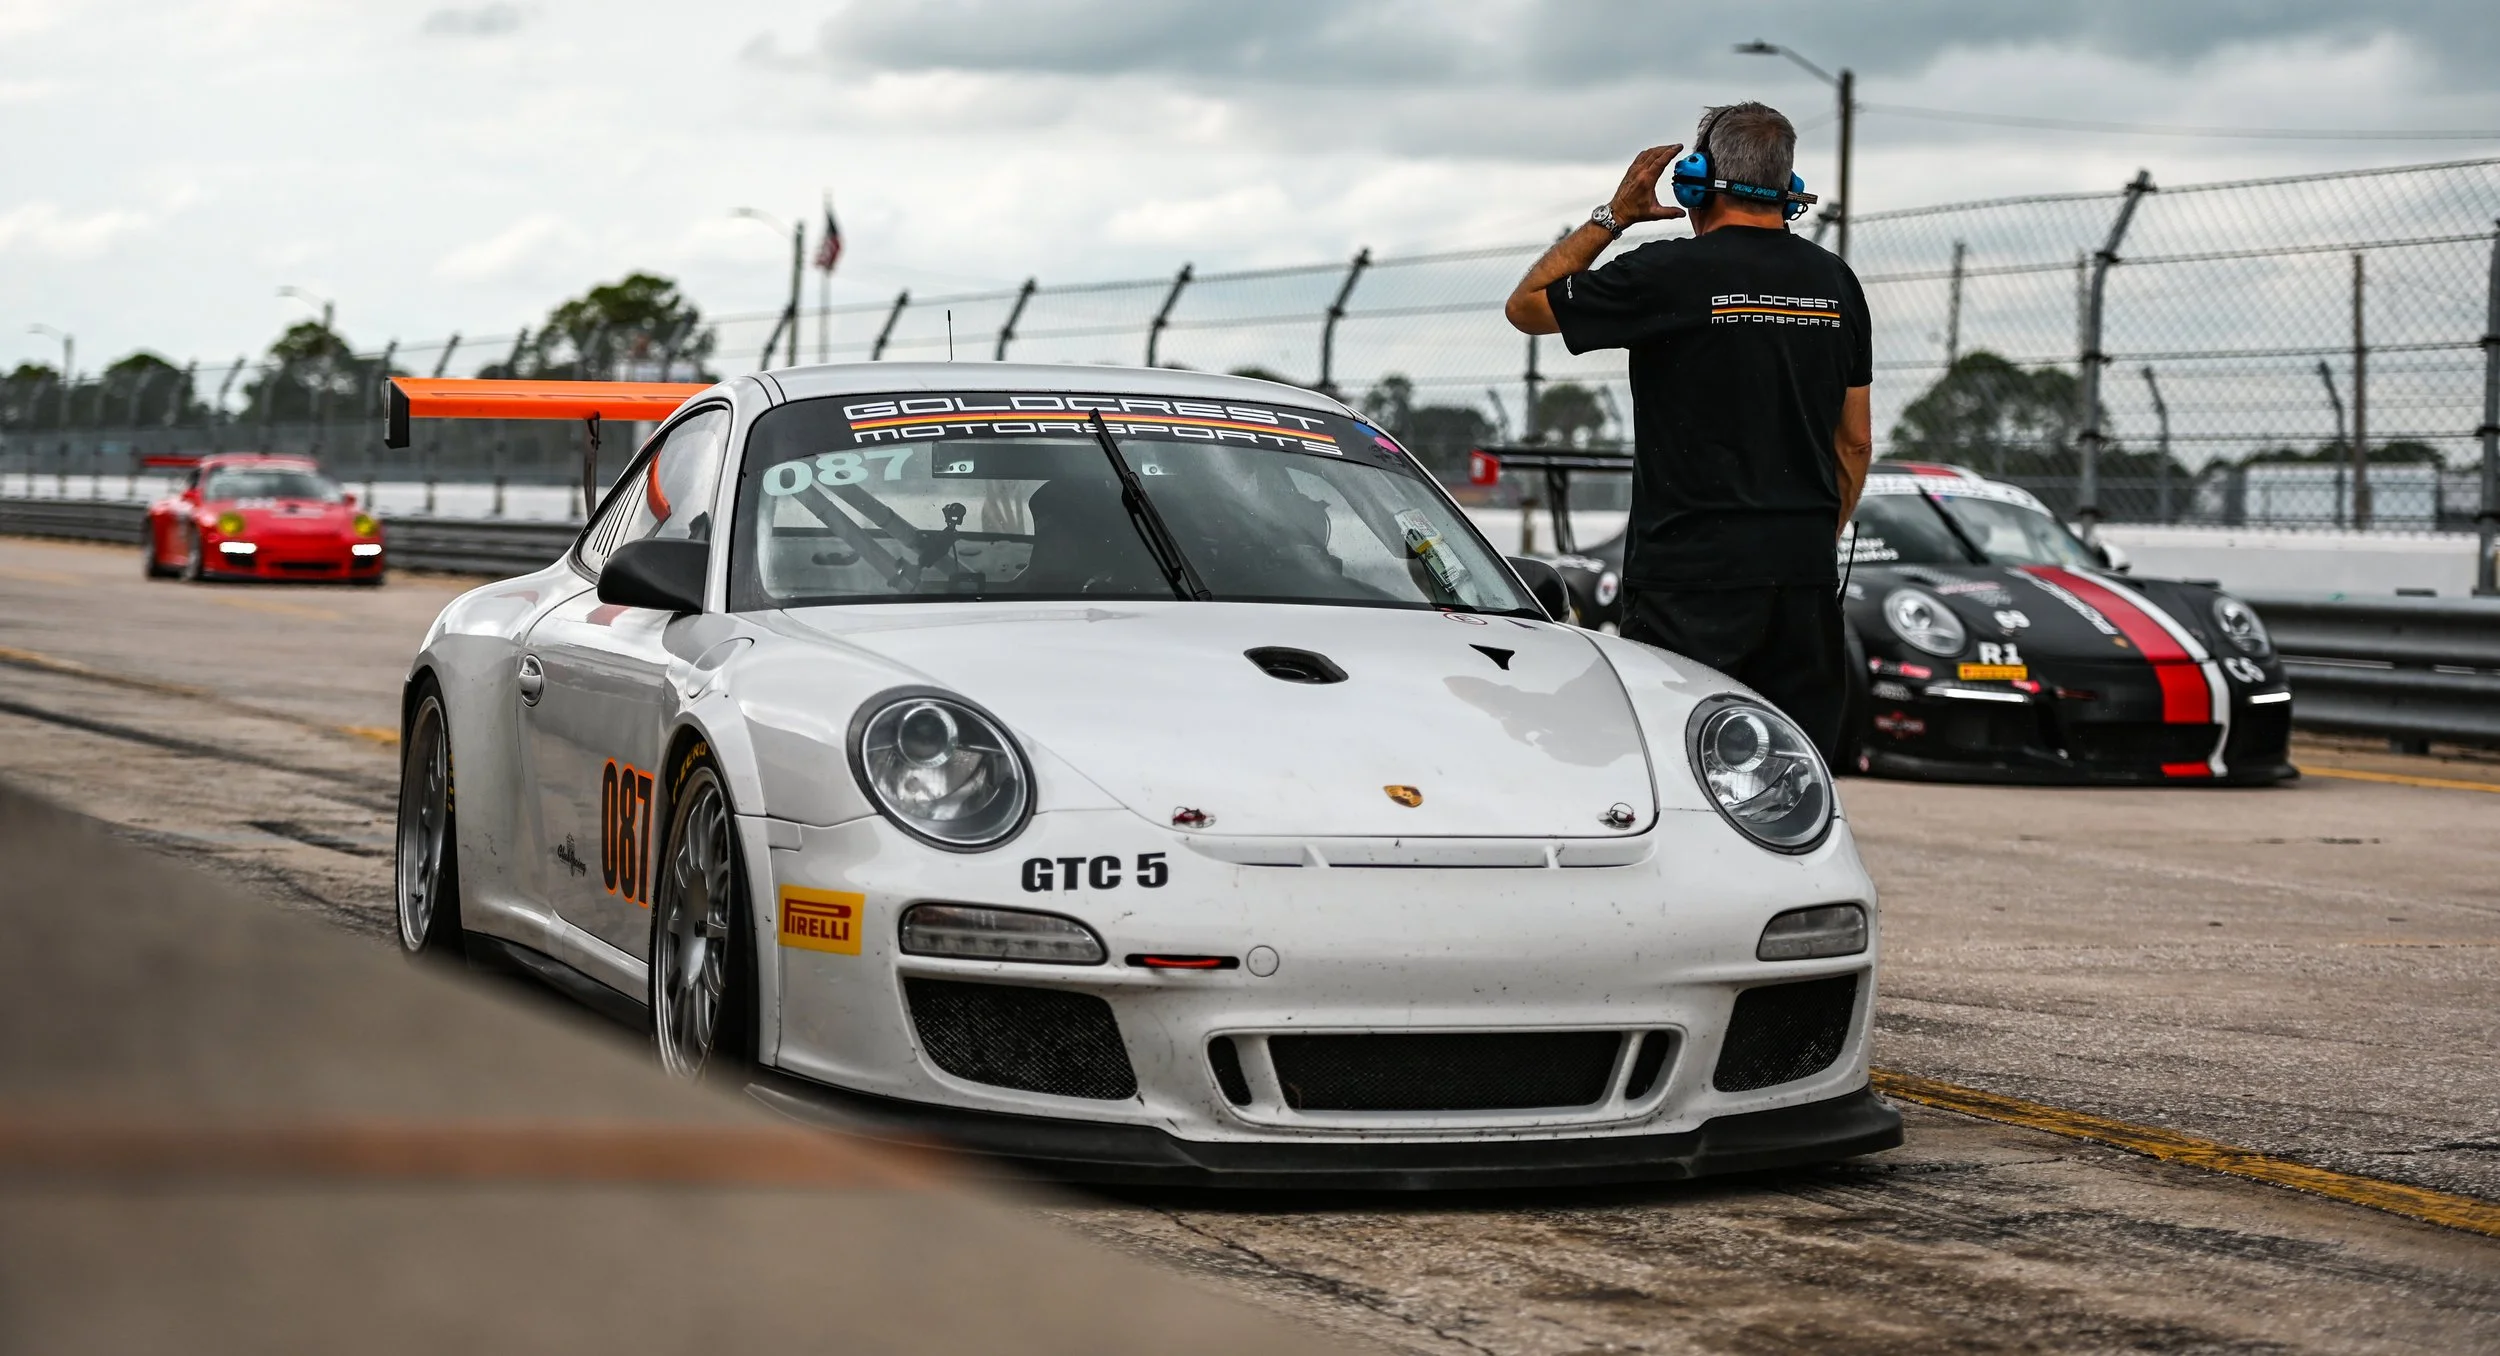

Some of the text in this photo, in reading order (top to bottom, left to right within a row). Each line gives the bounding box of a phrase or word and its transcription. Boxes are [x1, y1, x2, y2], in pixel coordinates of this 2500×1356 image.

[1712, 294, 1839, 309] GOLDCREST
[1711, 314, 1840, 328] MOTORSPORTS
[843, 396, 1325, 430] GOLDCREST
[854, 422, 1343, 456] MOTORSPORTS
[763, 448, 913, 496] 087
[1978, 641, 2024, 666] R1
[602, 757, 654, 908] 087
[1021, 852, 1169, 893] GTC 5
[784, 898, 852, 941] PIRELLI
